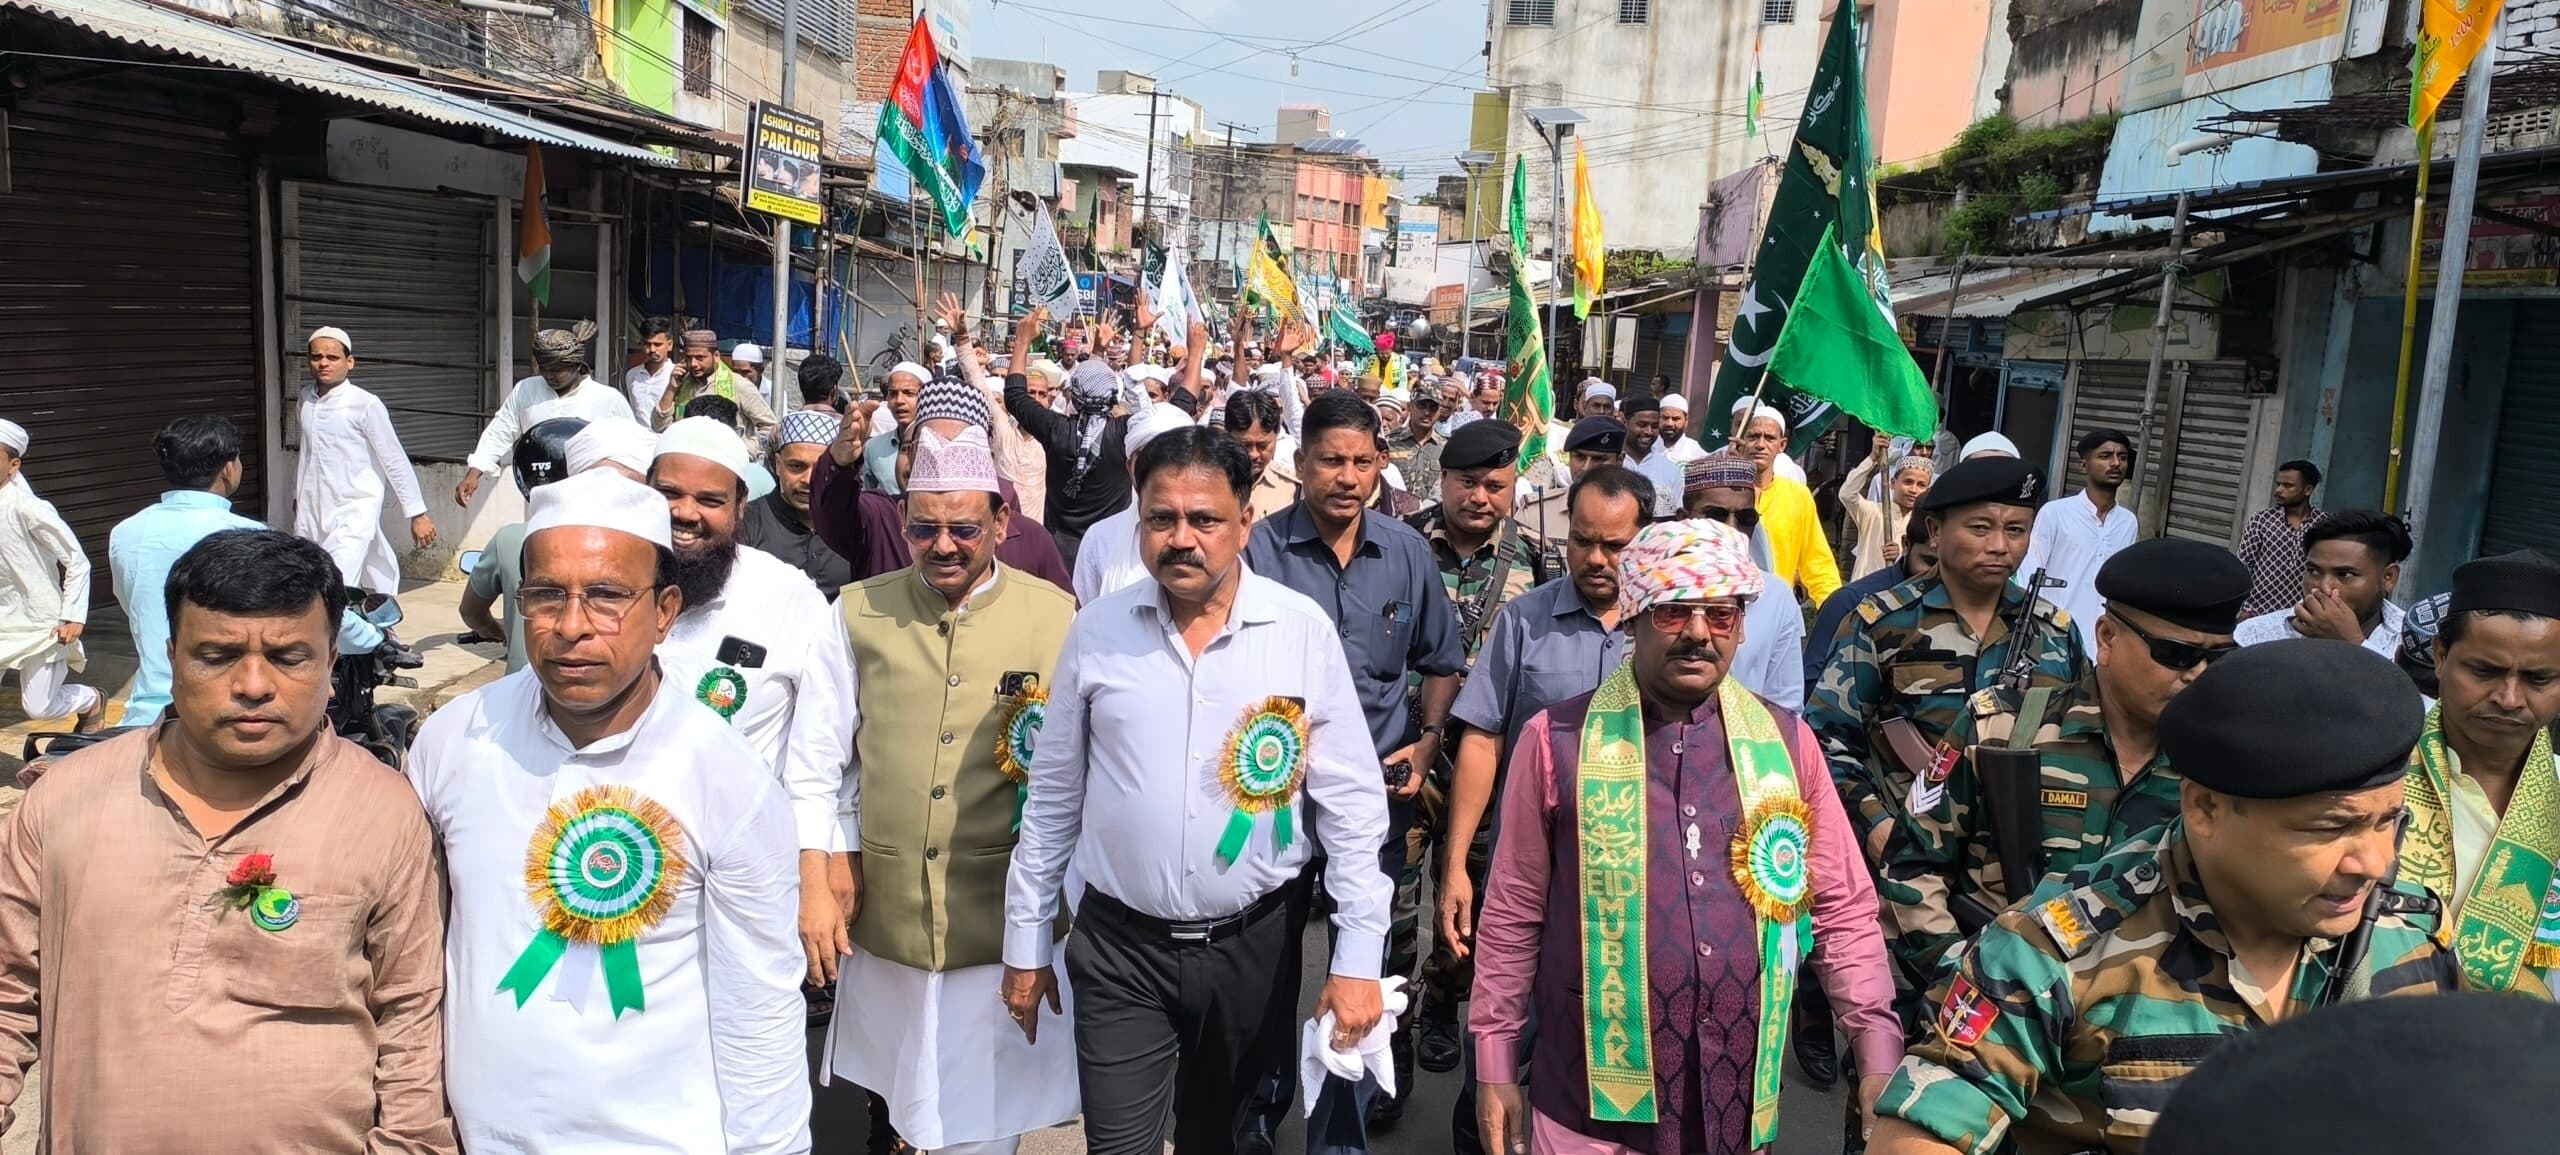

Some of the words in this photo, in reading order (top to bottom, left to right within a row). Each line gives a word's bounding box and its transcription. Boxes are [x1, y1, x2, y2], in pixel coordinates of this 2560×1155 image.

[761, 113, 793, 133] ASHOKA
[795, 124, 821, 141] GENTS
[760, 128, 820, 163] PARLOUR
[531, 461, 552, 471] TVS
[1587, 869, 1639, 897] EID
[1597, 896, 1632, 1068] MUBARAK
